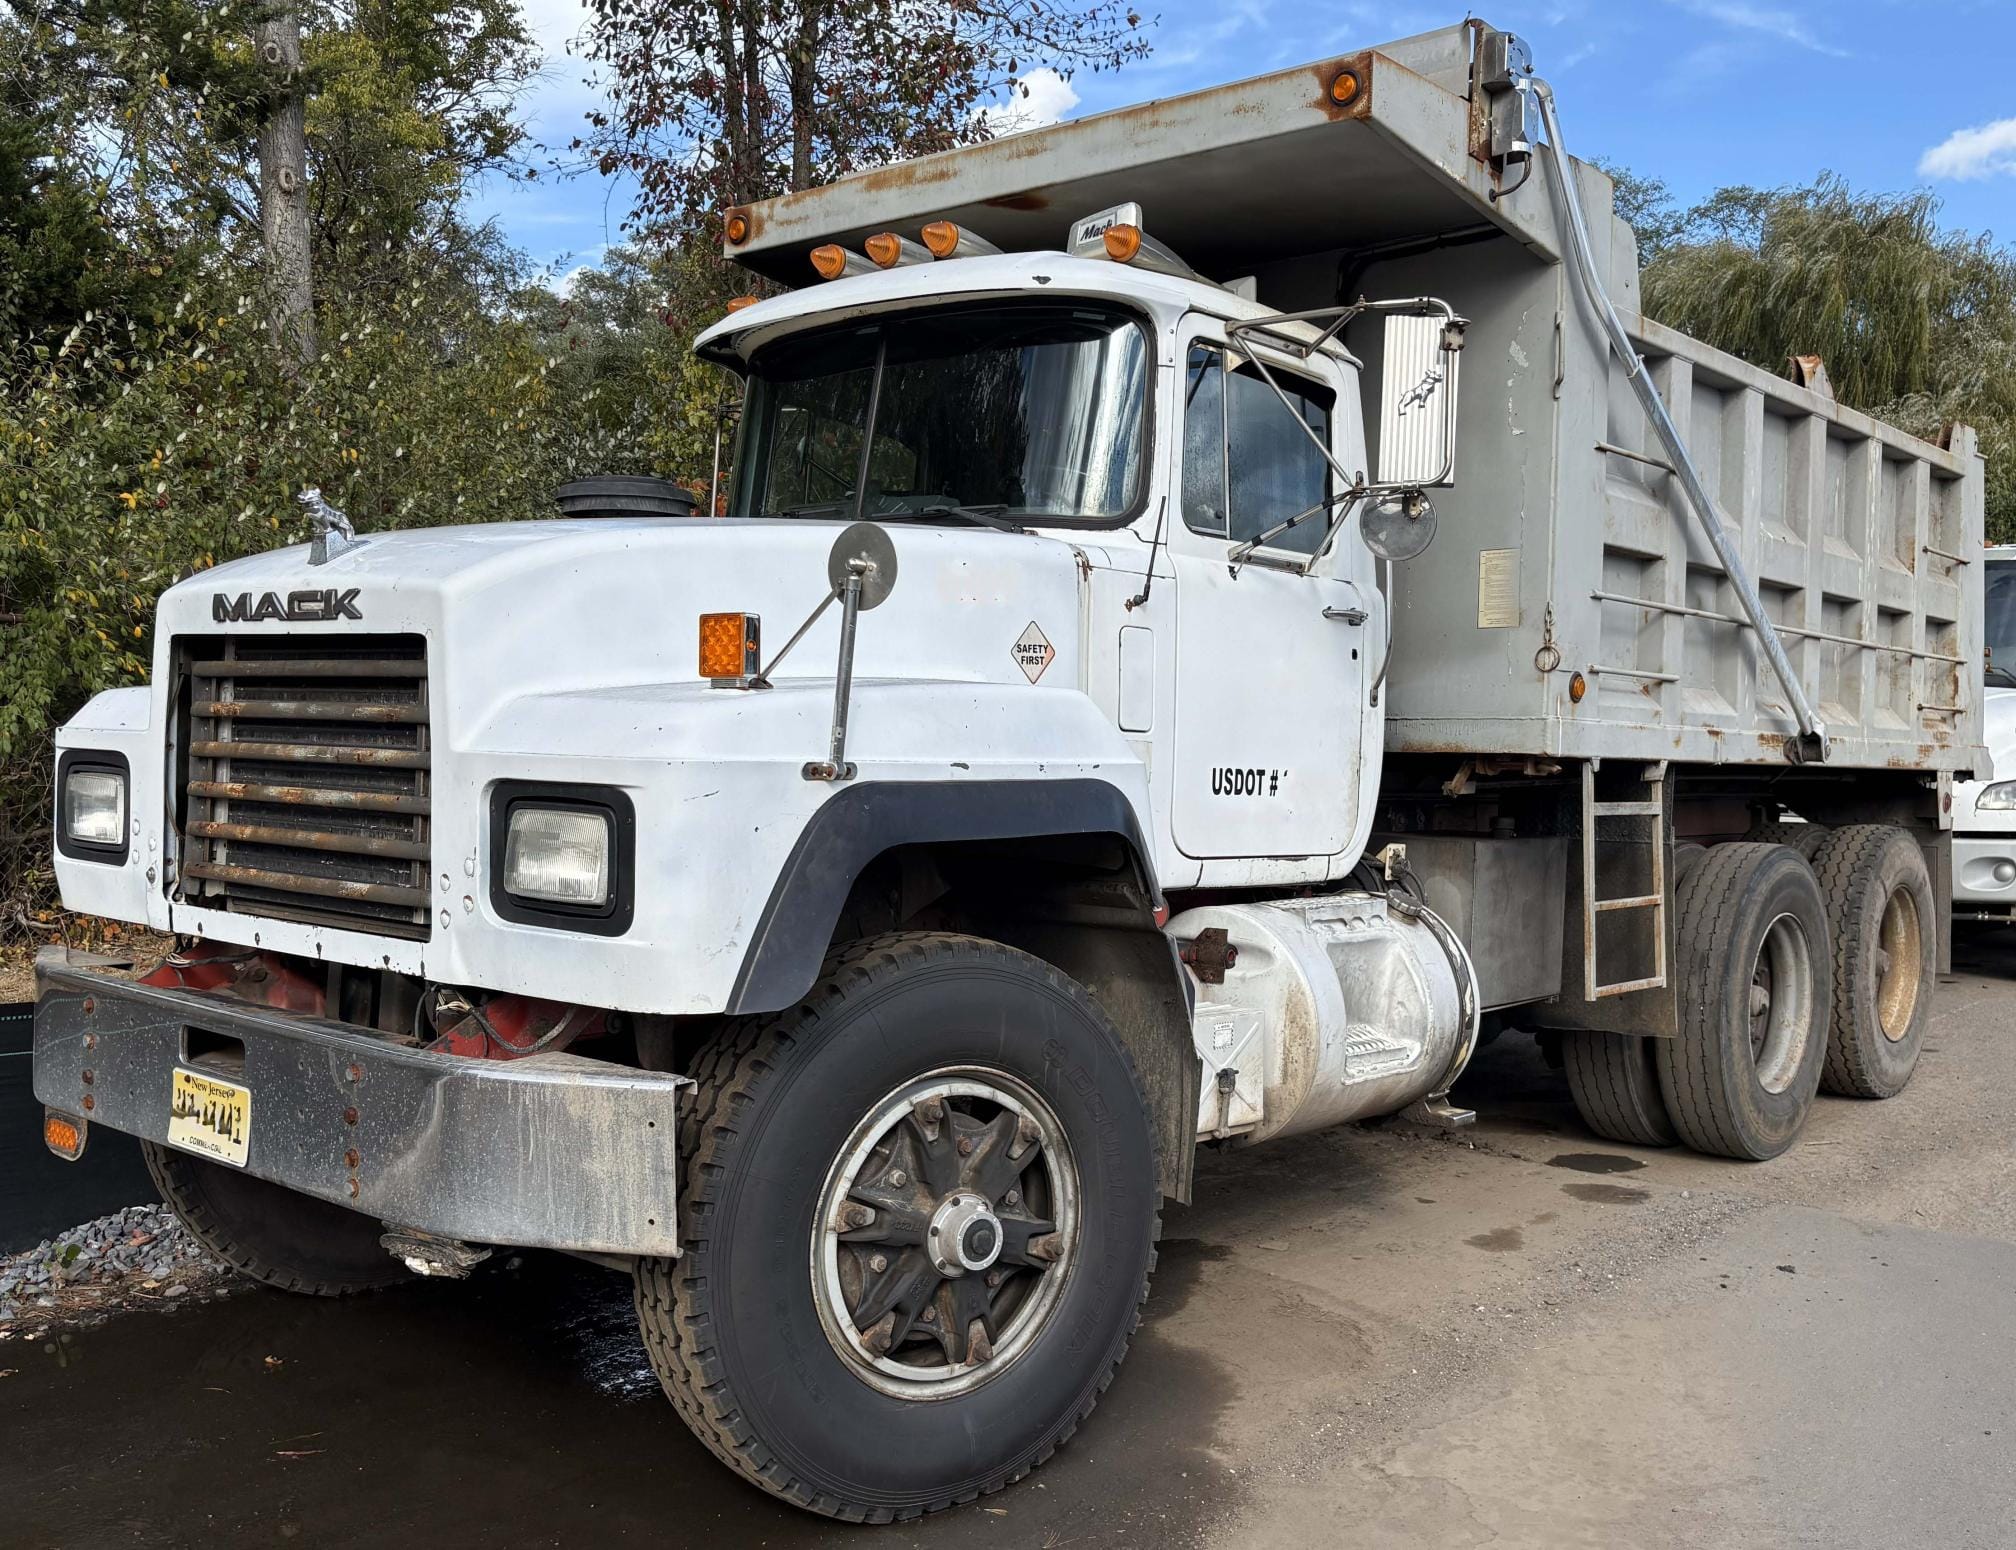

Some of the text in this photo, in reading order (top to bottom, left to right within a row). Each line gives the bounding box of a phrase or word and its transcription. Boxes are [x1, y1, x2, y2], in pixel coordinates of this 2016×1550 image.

[211, 587, 363, 622] MACK
[1016, 643, 1049, 654] SAFETY
[1020, 655, 1045, 666] FIRST
[1212, 767, 1265, 796] USDOT
[191, 1077, 230, 1100] New Jersey
